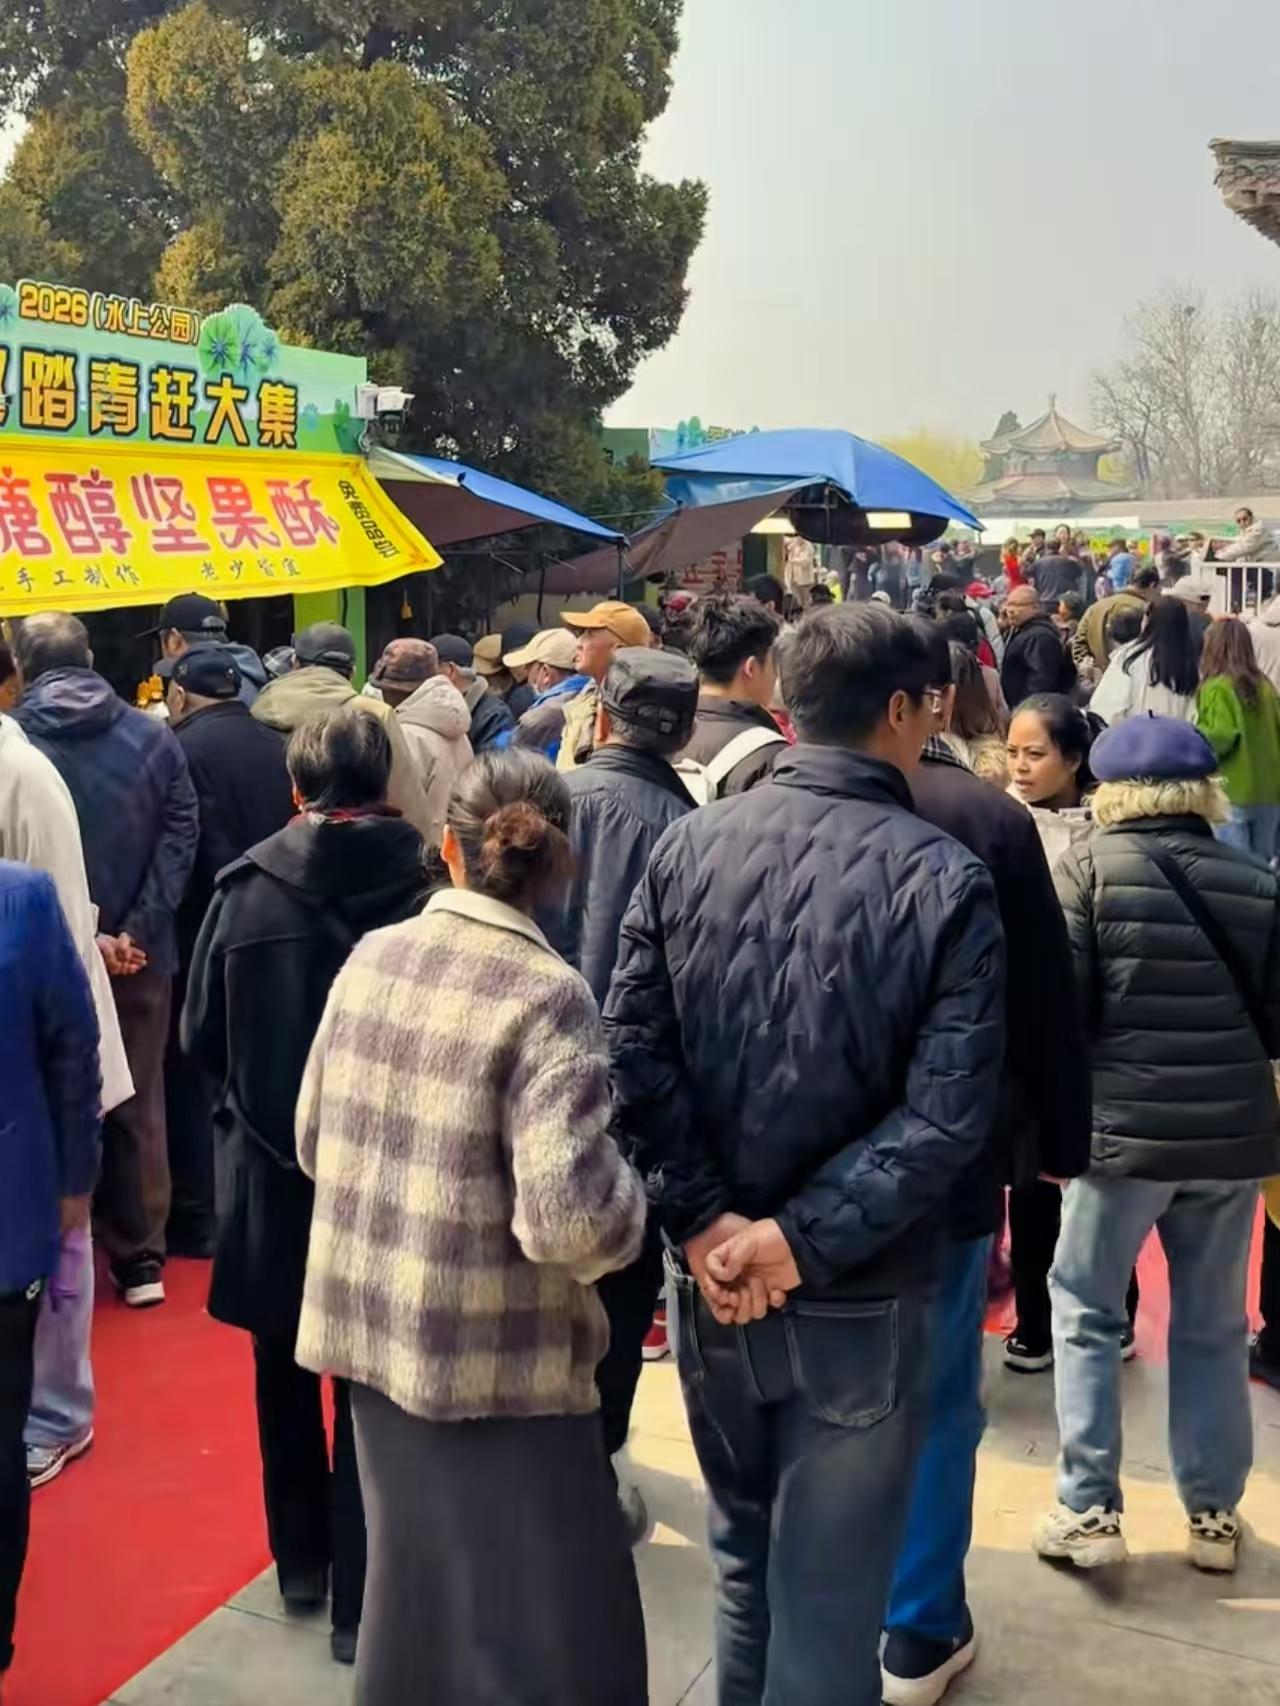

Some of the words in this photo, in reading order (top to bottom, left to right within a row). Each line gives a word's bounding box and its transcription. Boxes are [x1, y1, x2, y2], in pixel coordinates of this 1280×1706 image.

[0, 346, 299, 449] 踏青赶大集
[0, 564, 140, 592] 手工制作
